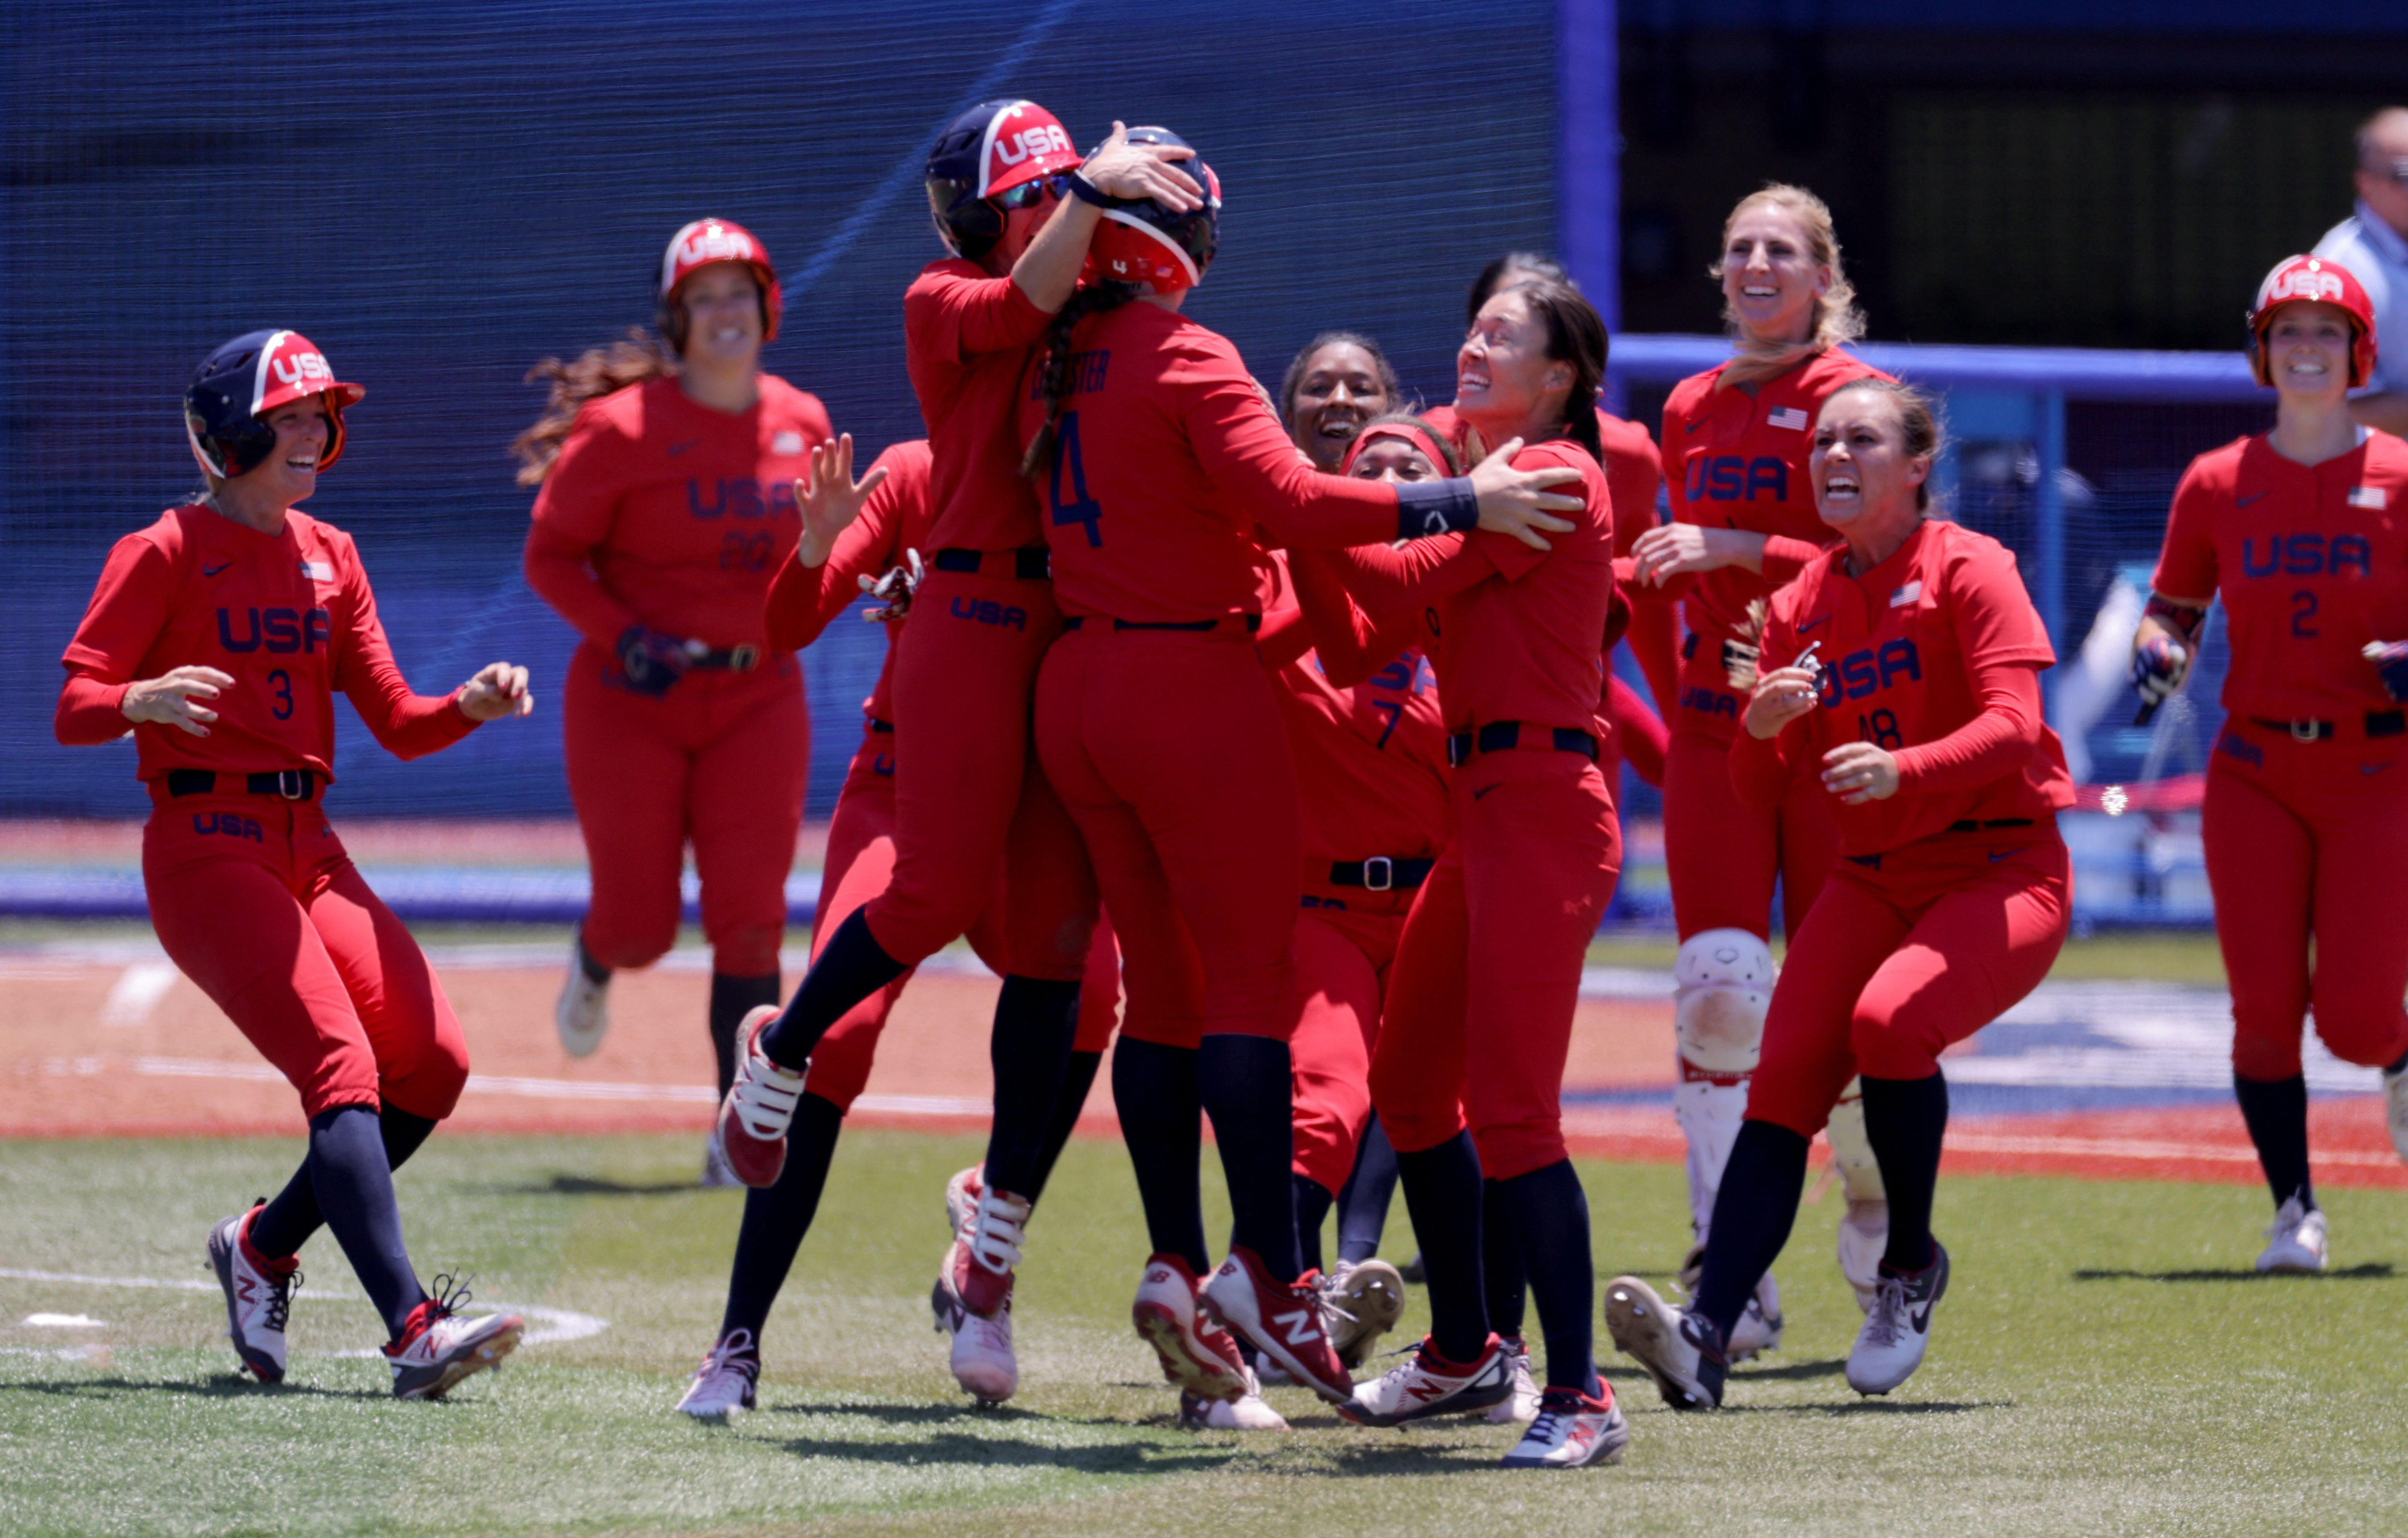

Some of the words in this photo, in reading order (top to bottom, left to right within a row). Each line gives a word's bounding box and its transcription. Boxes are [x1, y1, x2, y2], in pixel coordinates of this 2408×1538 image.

[995, 124, 1070, 165] USA
[1112, 259, 1127, 275] 4
[2270, 269, 2343, 300] USA
[1050, 410, 1103, 548] 4
[1685, 456, 1788, 501] USA
[2242, 534, 2371, 578] USA
[217, 607, 330, 654] USA
[950, 596, 1027, 631] USA
[2292, 589, 2319, 638] 2
[267, 669, 293, 720] 3
[1680, 686, 1737, 718] USA
[1372, 699, 1402, 749] 7
[193, 813, 263, 843] USA
[1273, 1310, 1320, 1345] N
[1407, 1378, 1444, 1402] N
